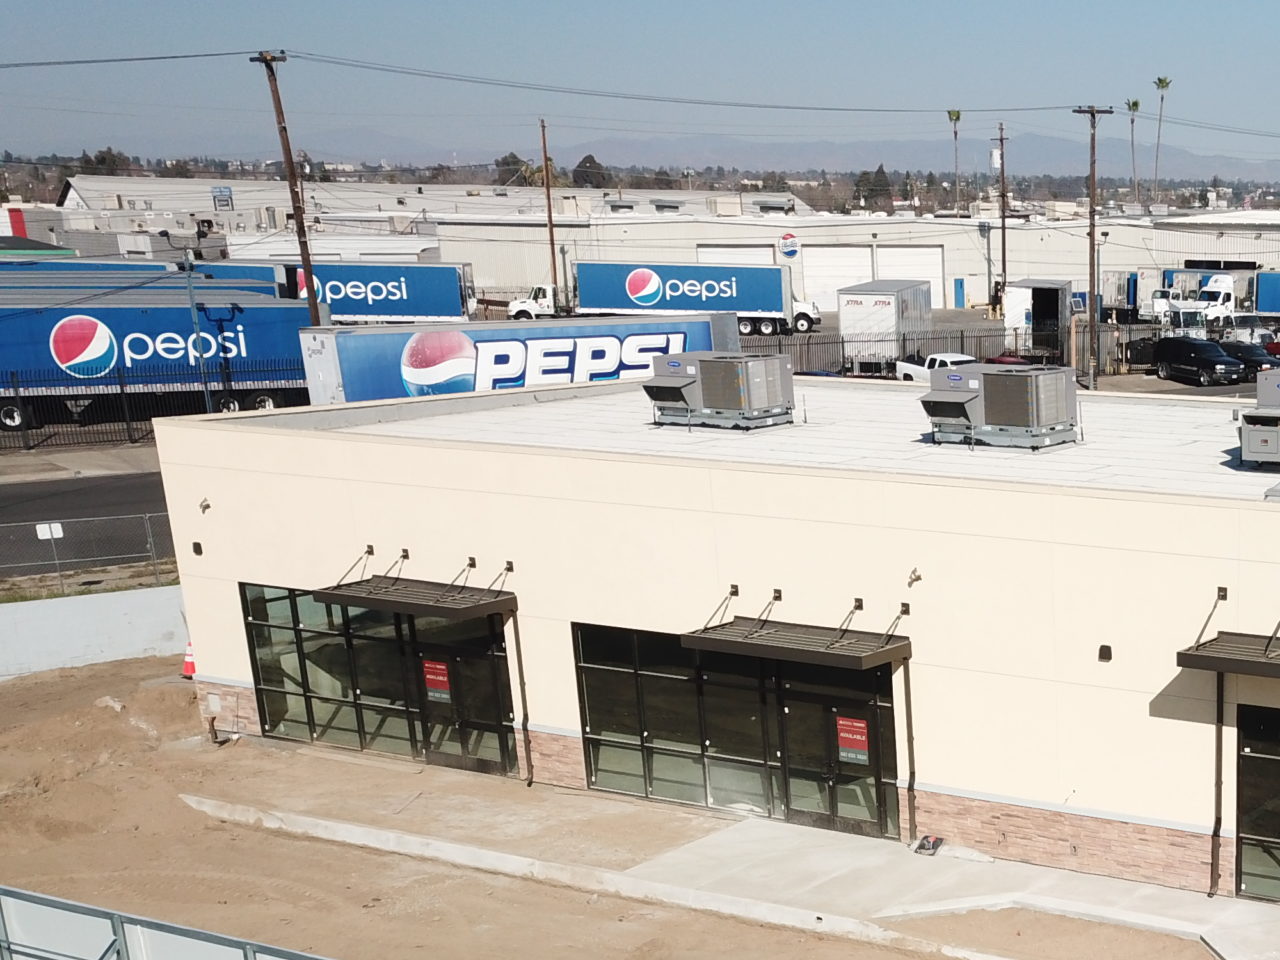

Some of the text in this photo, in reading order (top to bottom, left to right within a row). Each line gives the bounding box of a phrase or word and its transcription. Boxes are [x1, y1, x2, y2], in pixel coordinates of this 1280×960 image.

[325, 277, 408, 304] pepsi
[665, 277, 737, 302] pepsi
[123, 324, 248, 368] pepsi
[840, 732, 866, 741] AVAILABLE
